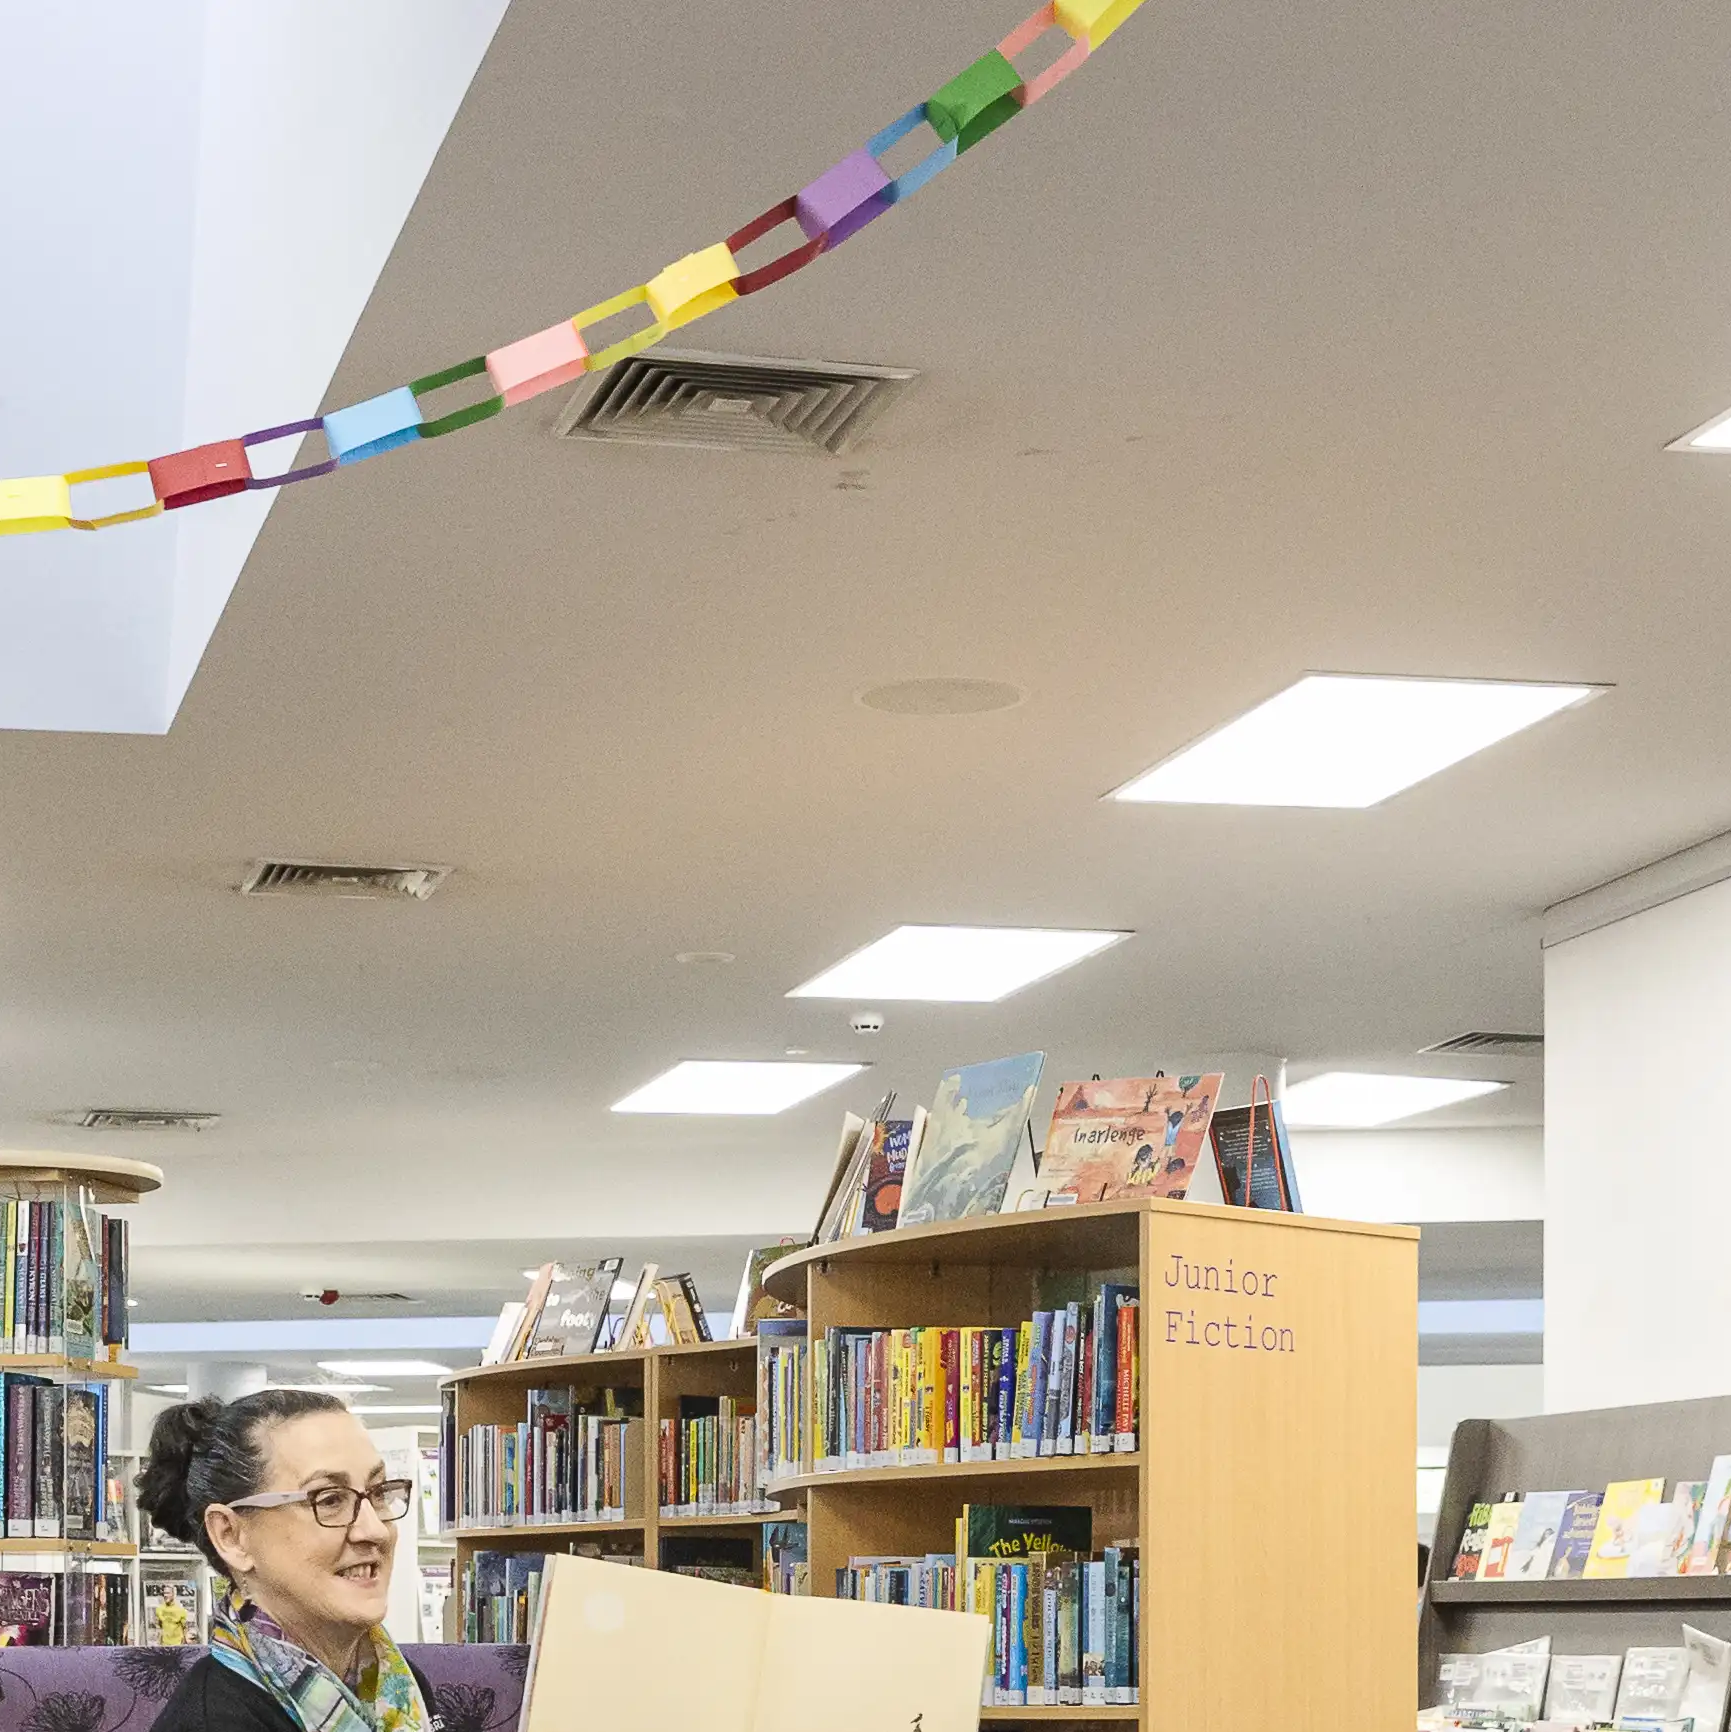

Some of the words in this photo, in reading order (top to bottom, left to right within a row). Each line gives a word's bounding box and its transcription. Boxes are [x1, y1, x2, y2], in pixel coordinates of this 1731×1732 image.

[1165, 1254, 1278, 1297] Junior
[1165, 1310, 1295, 1353] Fiction
[1122, 1369, 1130, 1410] MICHELLE
[988, 1538, 1021, 1558] The
